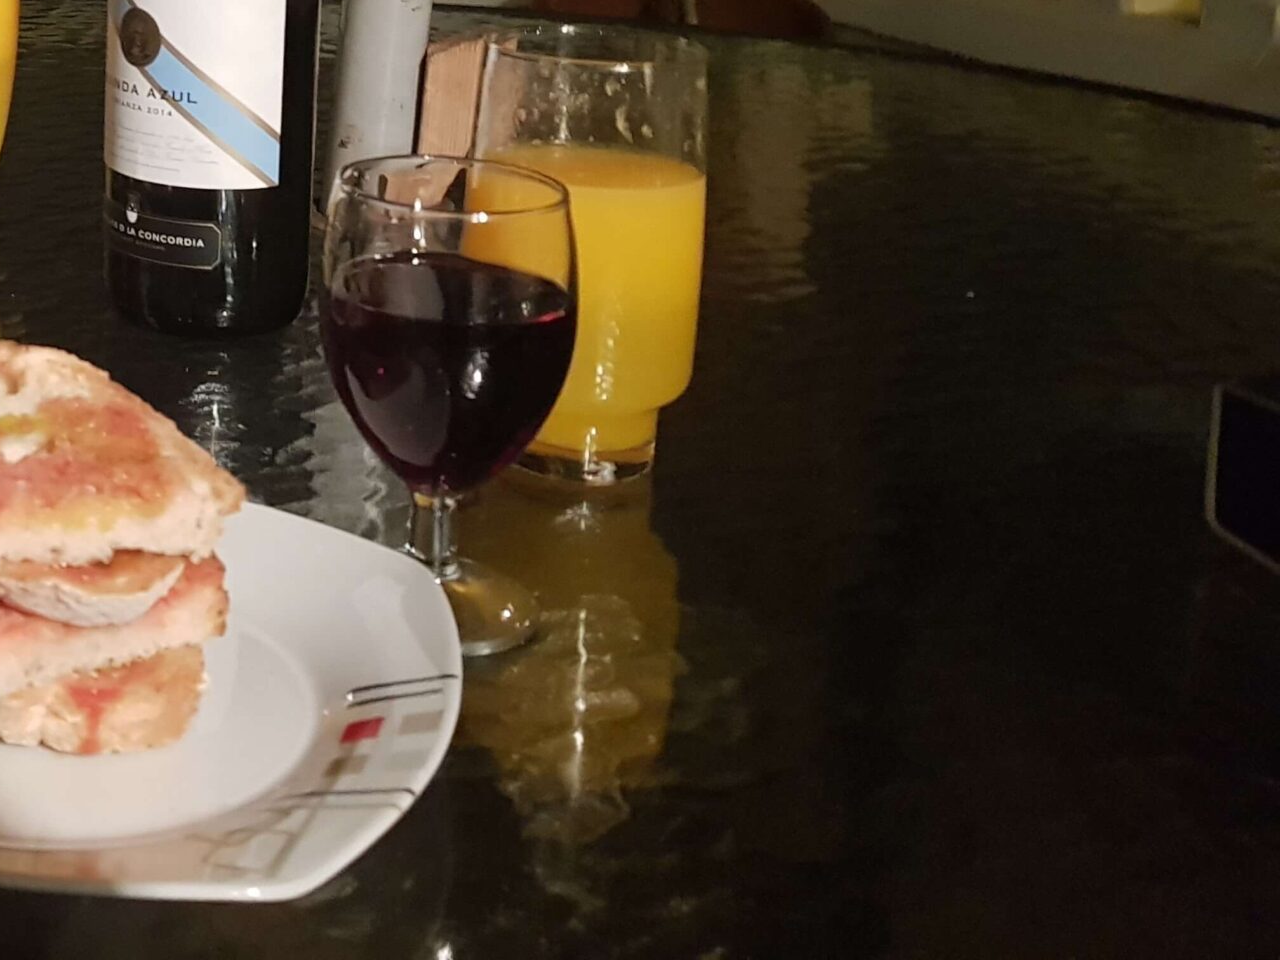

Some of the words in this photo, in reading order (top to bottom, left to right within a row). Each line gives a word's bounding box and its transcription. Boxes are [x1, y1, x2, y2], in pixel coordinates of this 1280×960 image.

[146, 88, 198, 104] AZUL
[146, 106, 172, 117] 2014
[138, 229, 205, 248] CONCORDIA
